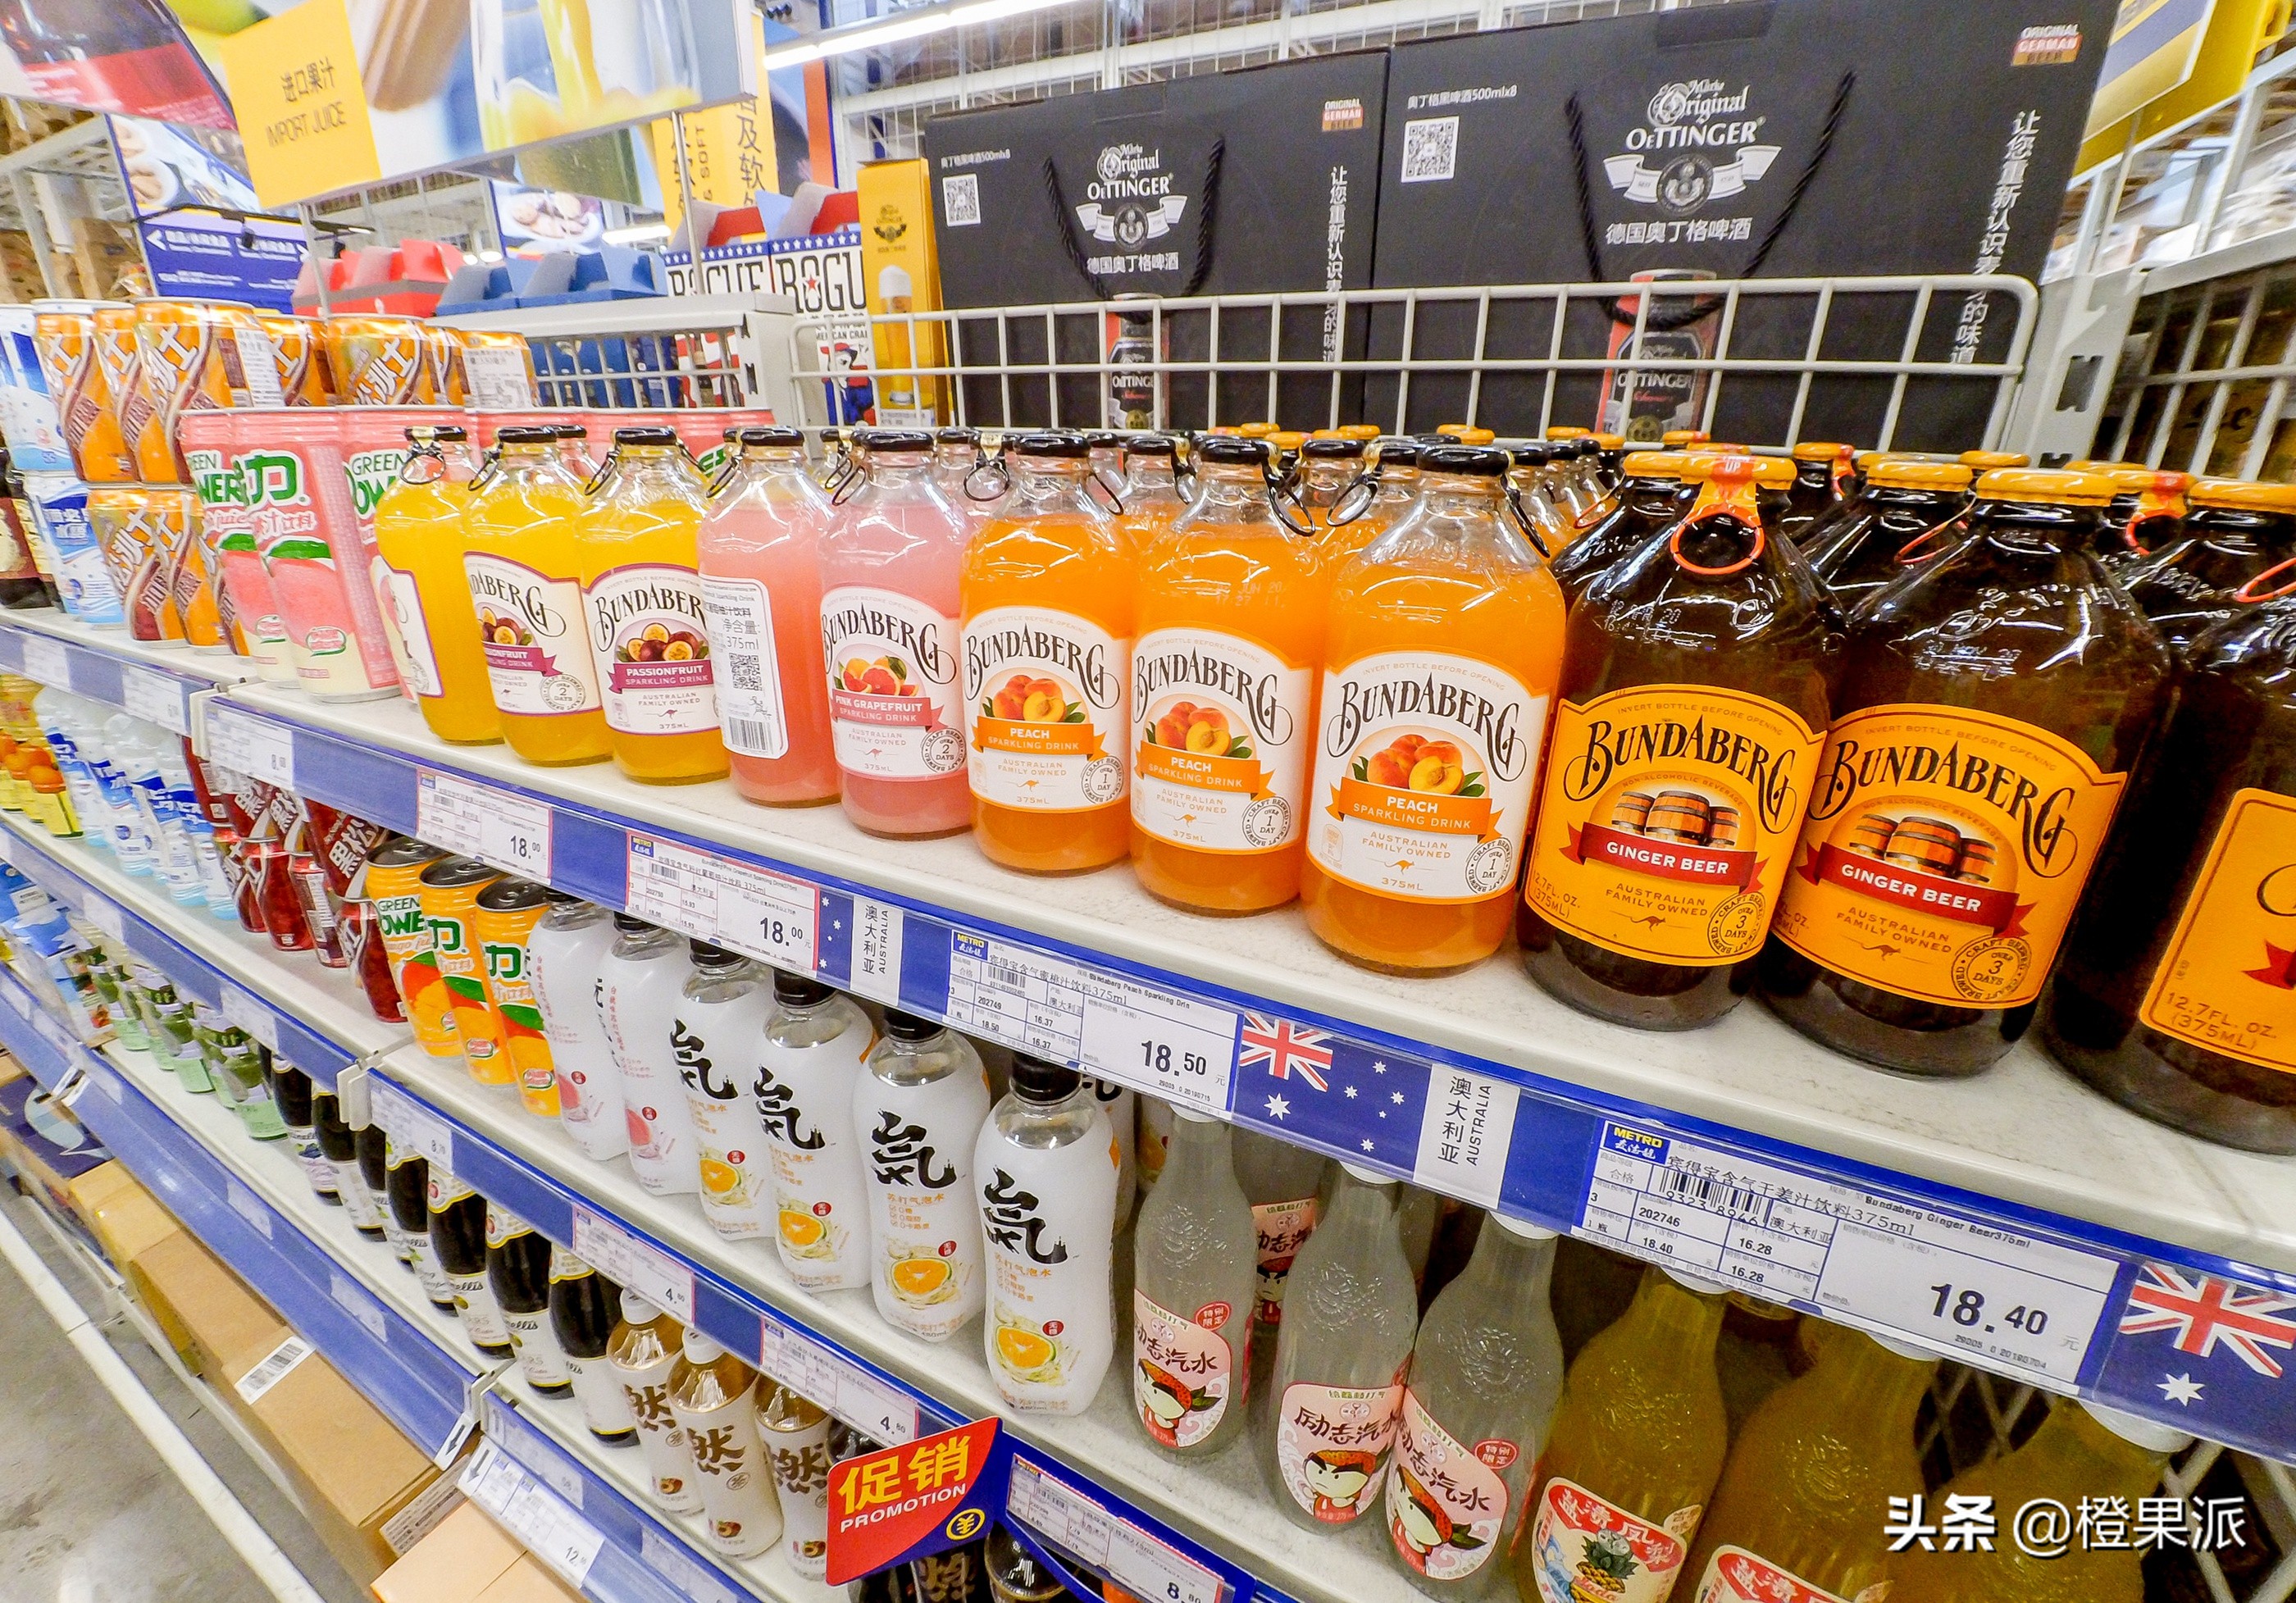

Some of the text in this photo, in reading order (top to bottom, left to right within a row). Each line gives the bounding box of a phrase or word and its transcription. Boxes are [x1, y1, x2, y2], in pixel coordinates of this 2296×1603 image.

[2018, 36, 2078, 52] GERMAN
[280, 56, 336, 102] 进口果汁
[1647, 82, 1751, 127] Original
[265, 113, 311, 148] IMPORT
[1605, 217, 1753, 245] 德国奥丁格啤酒
[350, 452, 408, 476] GREEN
[594, 582, 707, 653] BUNDABER
[727, 636, 758, 650] 375ml
[822, 602, 957, 684] BUNDABERG
[626, 665, 704, 676] PASSIONFRUIT
[963, 623, 1121, 709] BUNDABERG
[1432, 663, 1468, 675] BEFORE
[626, 675, 708, 685] SPARKLING DRINK
[836, 695, 922, 713] PINK GRAPEFRUIT
[1132, 646, 1293, 746] BUNDABERG
[840, 708, 917, 722] SPARKLING DRINK
[1618, 703, 1784, 736] INVERT BOTTLE BEFORE OPENING
[1010, 727, 1050, 740] PEACH
[1326, 672, 1527, 782] BUNDABERG
[874, 738, 907, 746] OWNED
[942, 744, 950, 754] 2
[988, 735, 1080, 751] SPARKLING DRINK
[998, 764, 1067, 776] FAMILY OWNED
[1003, 758, 1063, 768] AUSTRALIAN
[1171, 756, 1212, 773] PEACH
[1102, 774, 1108, 784] 1
[1148, 763, 1243, 789] SPARKLING DRINK
[1563, 714, 1797, 834] BUNDABERG
[1162, 788, 1223, 805] AUSTRALIAN
[1702, 779, 1744, 808] BEVERAGE
[1156, 794, 1228, 814] FAMILY OWNED
[1386, 795, 1438, 813] PEACH
[1807, 740, 2079, 878] BUNDABERG
[1266, 814, 1273, 827] 1
[1352, 802, 1472, 830] SPARKLING DRINK
[1260, 827, 1277, 835] DAY
[1370, 831, 1449, 850] AUSTRALIAN
[510, 835, 541, 859] 18.00
[1361, 837, 1451, 859] FAMILY OWNED
[1489, 858, 1496, 871] 1
[1606, 840, 1730, 875] GINGER BEER
[1482, 871, 1497, 879] DAY
[1615, 881, 1706, 907] AUSTRALIAN
[1841, 863, 1983, 913] GINGER BEER
[377, 896, 421, 912] GREEN
[1605, 888, 1709, 918] FAMILY OWNED
[759, 917, 804, 947] 18.00
[1736, 915, 1747, 929] 3
[1848, 906, 1951, 943] AUSTRALIAN
[862, 904, 878, 975] 澳大利亚
[878, 909, 889, 975] AUSTRALIA
[956, 933, 985, 947] METRO
[1724, 929, 1748, 938] DAYS
[1836, 912, 1952, 954] FAMILY OWNED
[1988, 959, 2002, 976] 3
[1973, 972, 2005, 987] DAYS
[977, 995, 1002, 1011] 202749
[1144, 990, 1174, 1006] Sparkling
[982, 1019, 1000, 1032] 18.50
[1034, 1014, 1054, 1028] 16.37
[2166, 991, 2277, 1040] 12.7FL. OZ.
[2171, 1013, 2257, 1051] (375ML)
[1032, 1036, 1051, 1050] 16.37
[1141, 1039, 1226, 1086] 18.50 元
[1437, 1075, 1473, 1166] 澳大利亚
[1465, 1084, 1492, 1167] AUSTRALIA
[1613, 1126, 1664, 1150] METRO
[1610, 1168, 1635, 1184] 合格
[886, 1191, 945, 1206] 苏打气泡水
[1590, 1192, 1598, 1202] 3
[1638, 1207, 1681, 1227] 202746
[1864, 1195, 1924, 1221] Bundaberg
[1926, 1212, 1966, 1232] Ginger
[1968, 1223, 2032, 1250] Beer375ml
[1770, 1215, 1833, 1246] 澳大利亚
[1642, 1236, 1674, 1255] 18.40
[1738, 1236, 1773, 1256] 16.28
[1730, 1264, 1765, 1283] 16.28
[1930, 1282, 2080, 1352] 18.40 元
[880, 1414, 906, 1436] 4.80
[838, 1432, 971, 1515] 促销
[840, 1482, 968, 1533] PROMOTION
